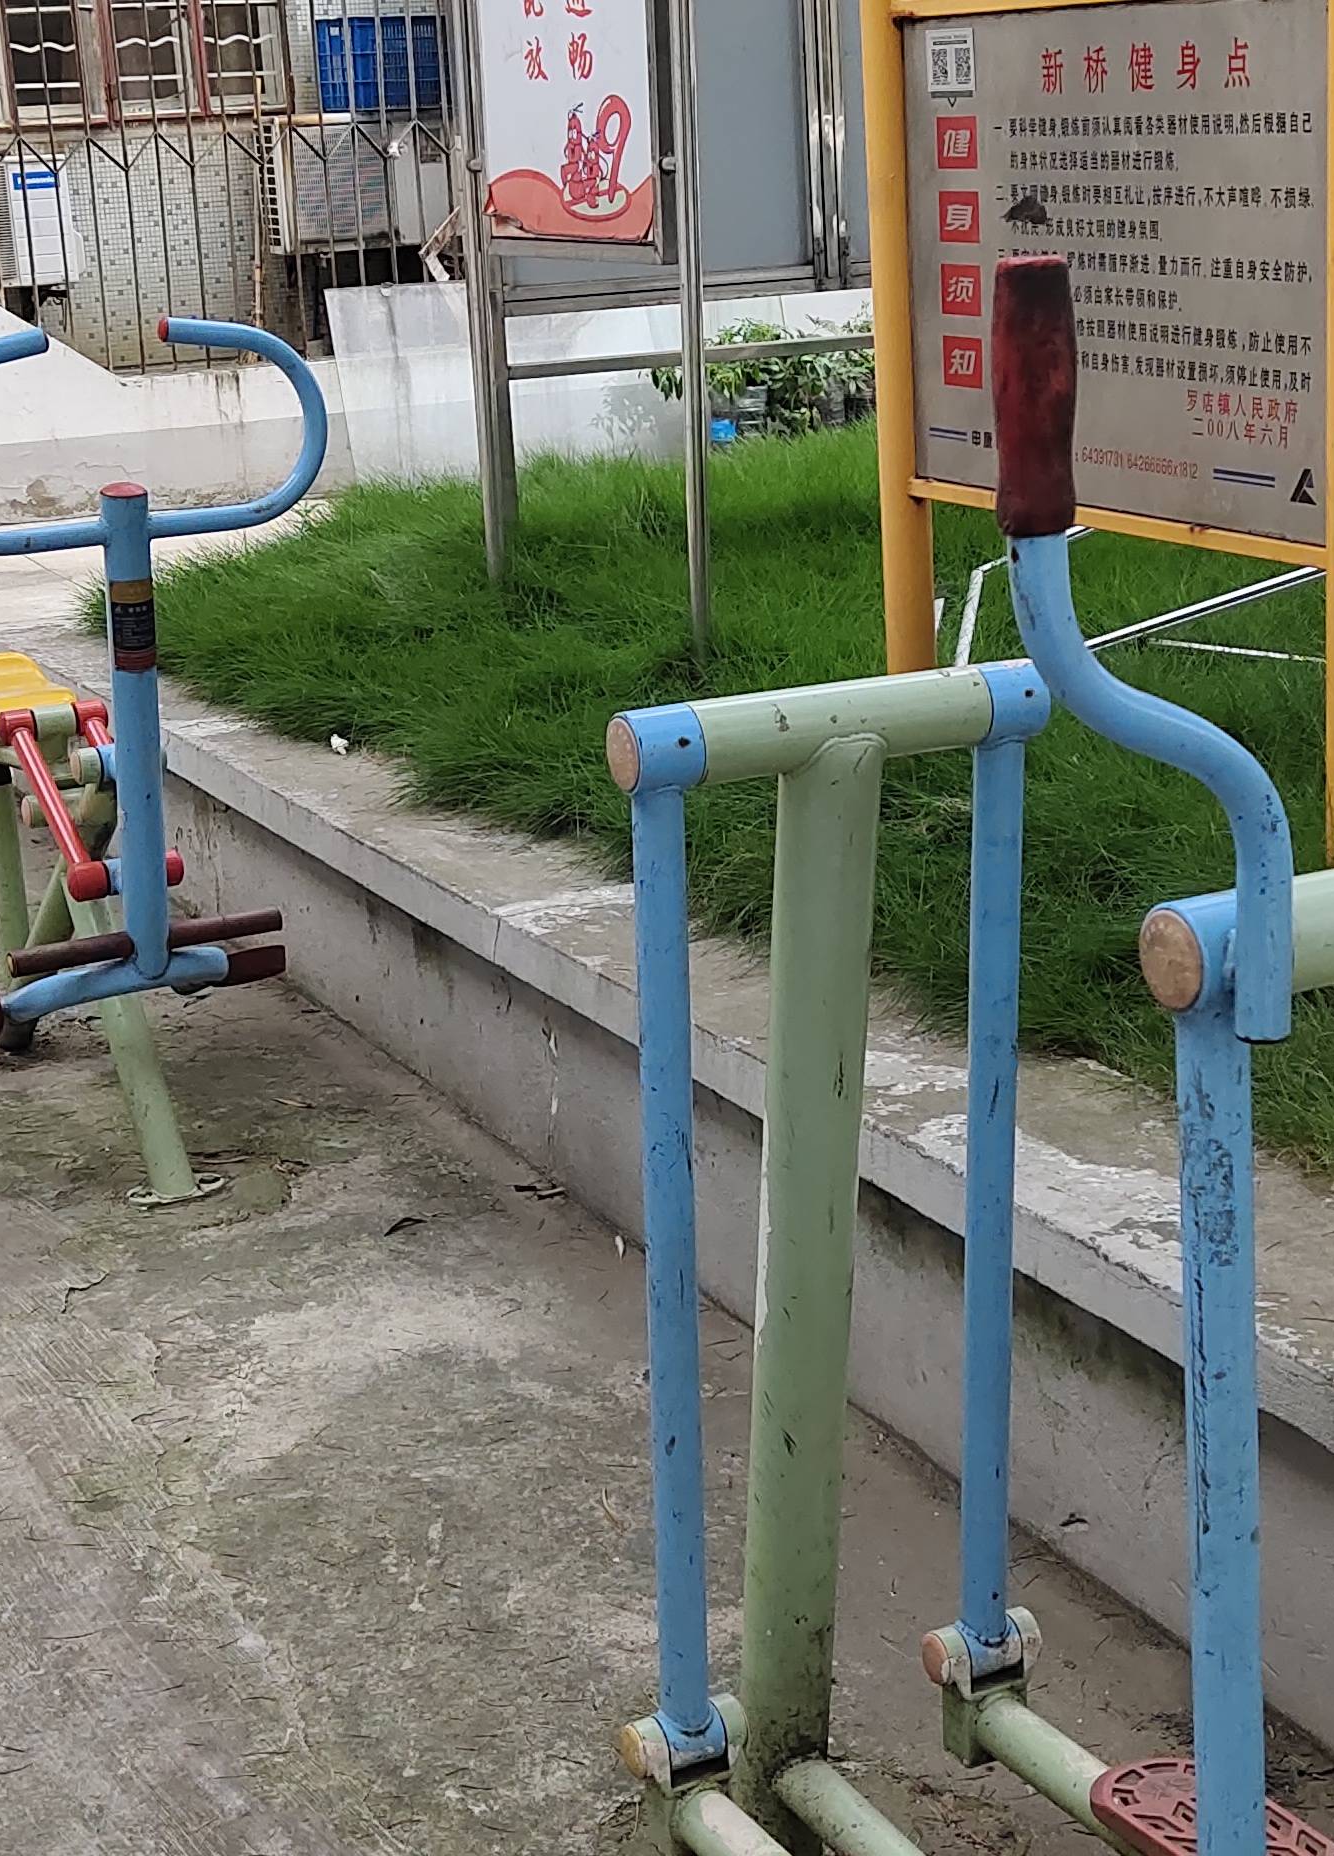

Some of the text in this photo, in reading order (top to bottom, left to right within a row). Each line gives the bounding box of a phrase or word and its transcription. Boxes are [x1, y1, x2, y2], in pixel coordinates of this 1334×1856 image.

[1041, 37, 1251, 95] 新桥健身点
[943, 129, 976, 375] 健身须知
[1187, 389, 1298, 424] 罗店镇人民政府
